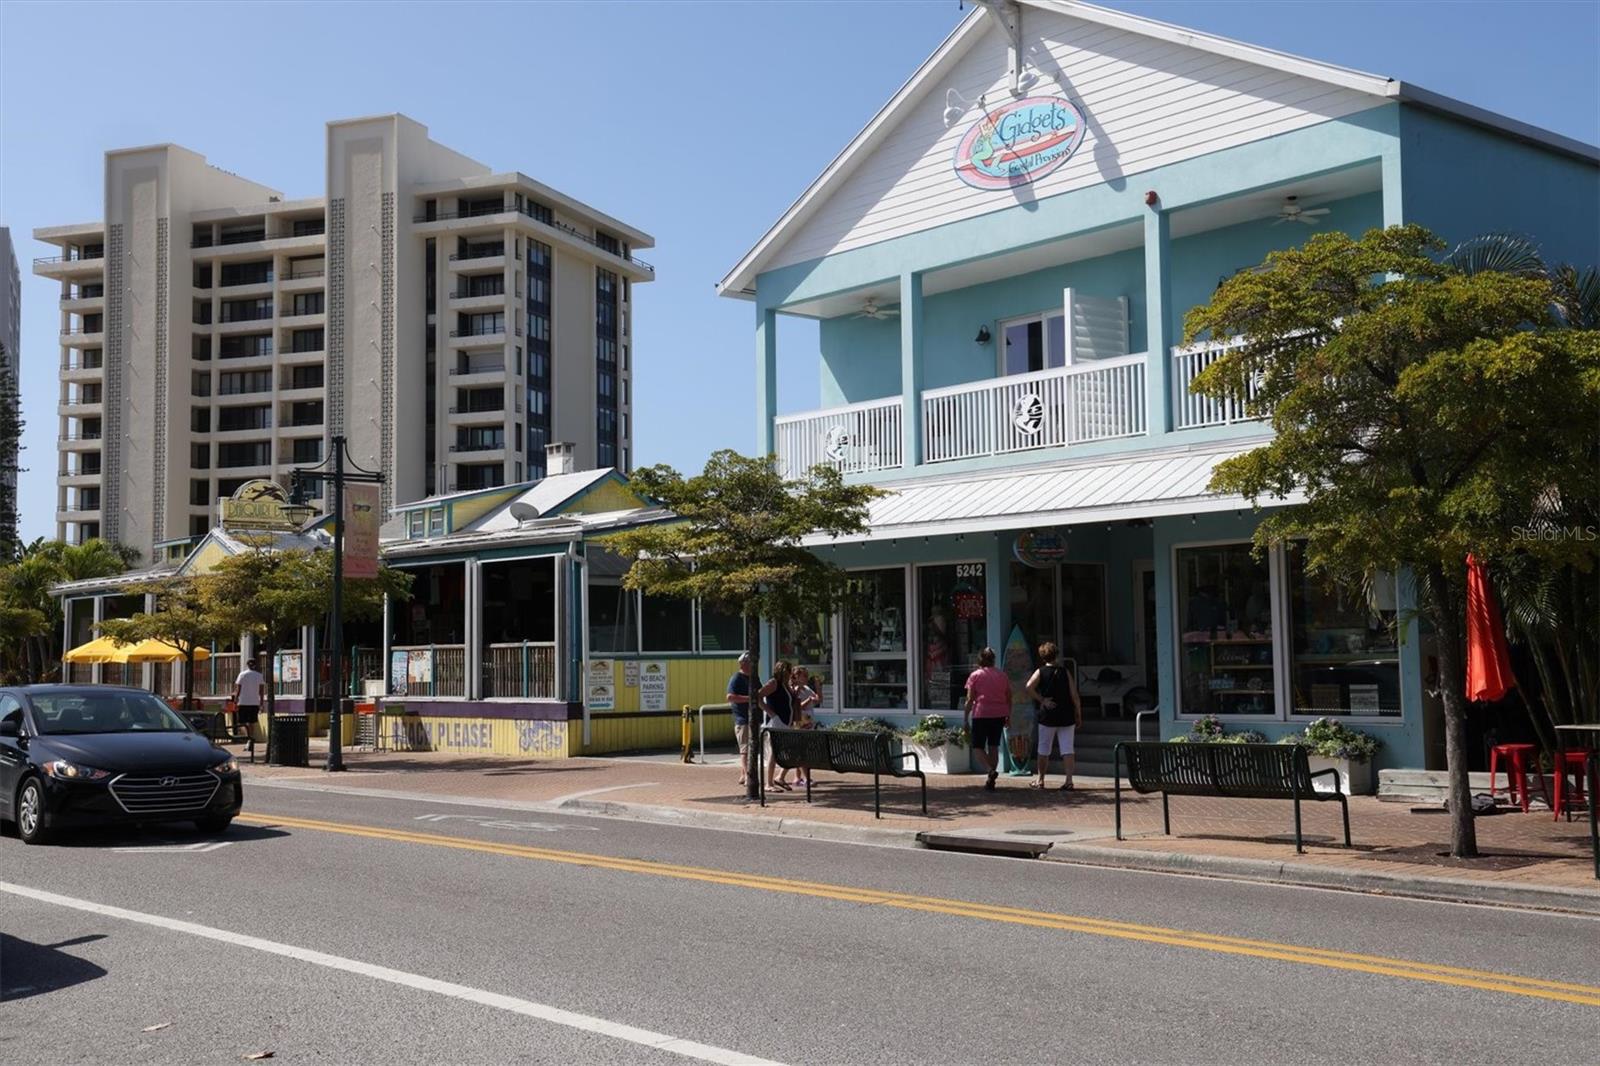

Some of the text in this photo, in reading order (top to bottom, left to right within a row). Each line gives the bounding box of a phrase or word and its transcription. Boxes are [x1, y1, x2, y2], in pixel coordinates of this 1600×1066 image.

[956, 564, 983, 577] 5242
[649, 674, 666, 682] BEACH
[438, 722, 493, 748] PLEASE!
